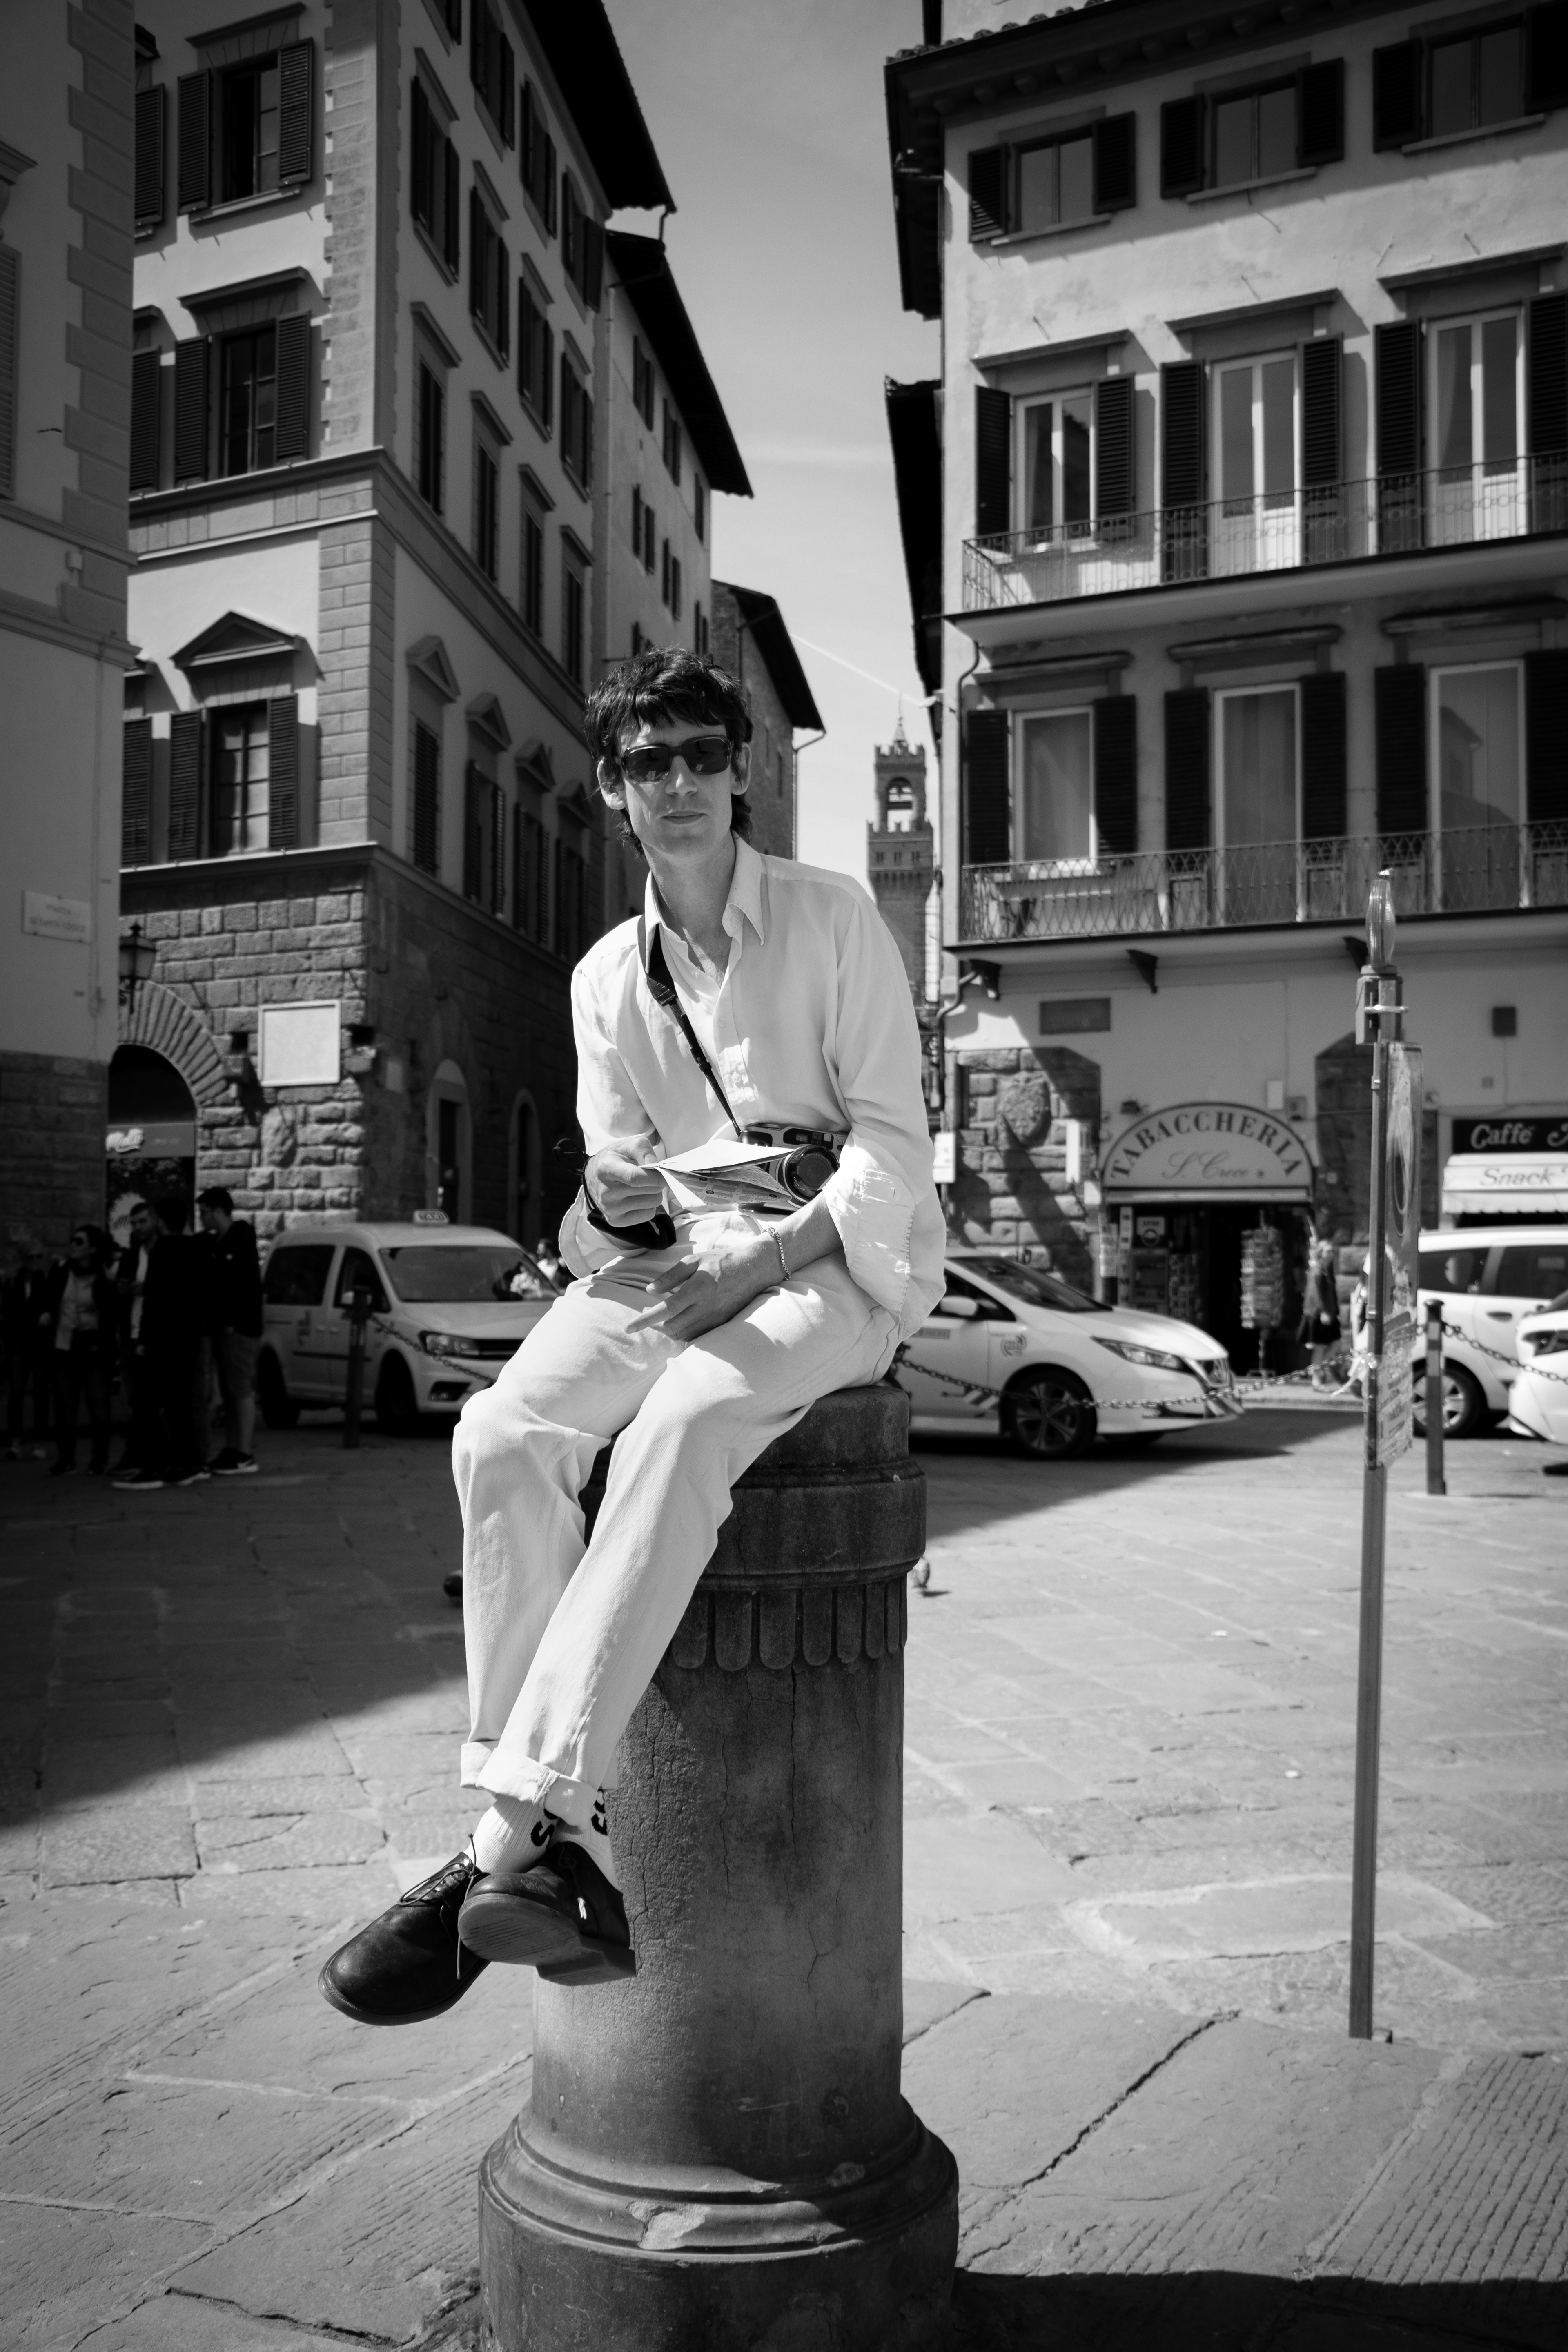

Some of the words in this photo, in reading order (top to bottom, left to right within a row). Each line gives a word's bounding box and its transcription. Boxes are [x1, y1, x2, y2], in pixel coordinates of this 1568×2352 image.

[1110, 1111, 1302, 1179] TABACCHERIA
[1197, 1151, 1248, 1179] Croce
[1480, 1167, 1555, 1186] Snack
